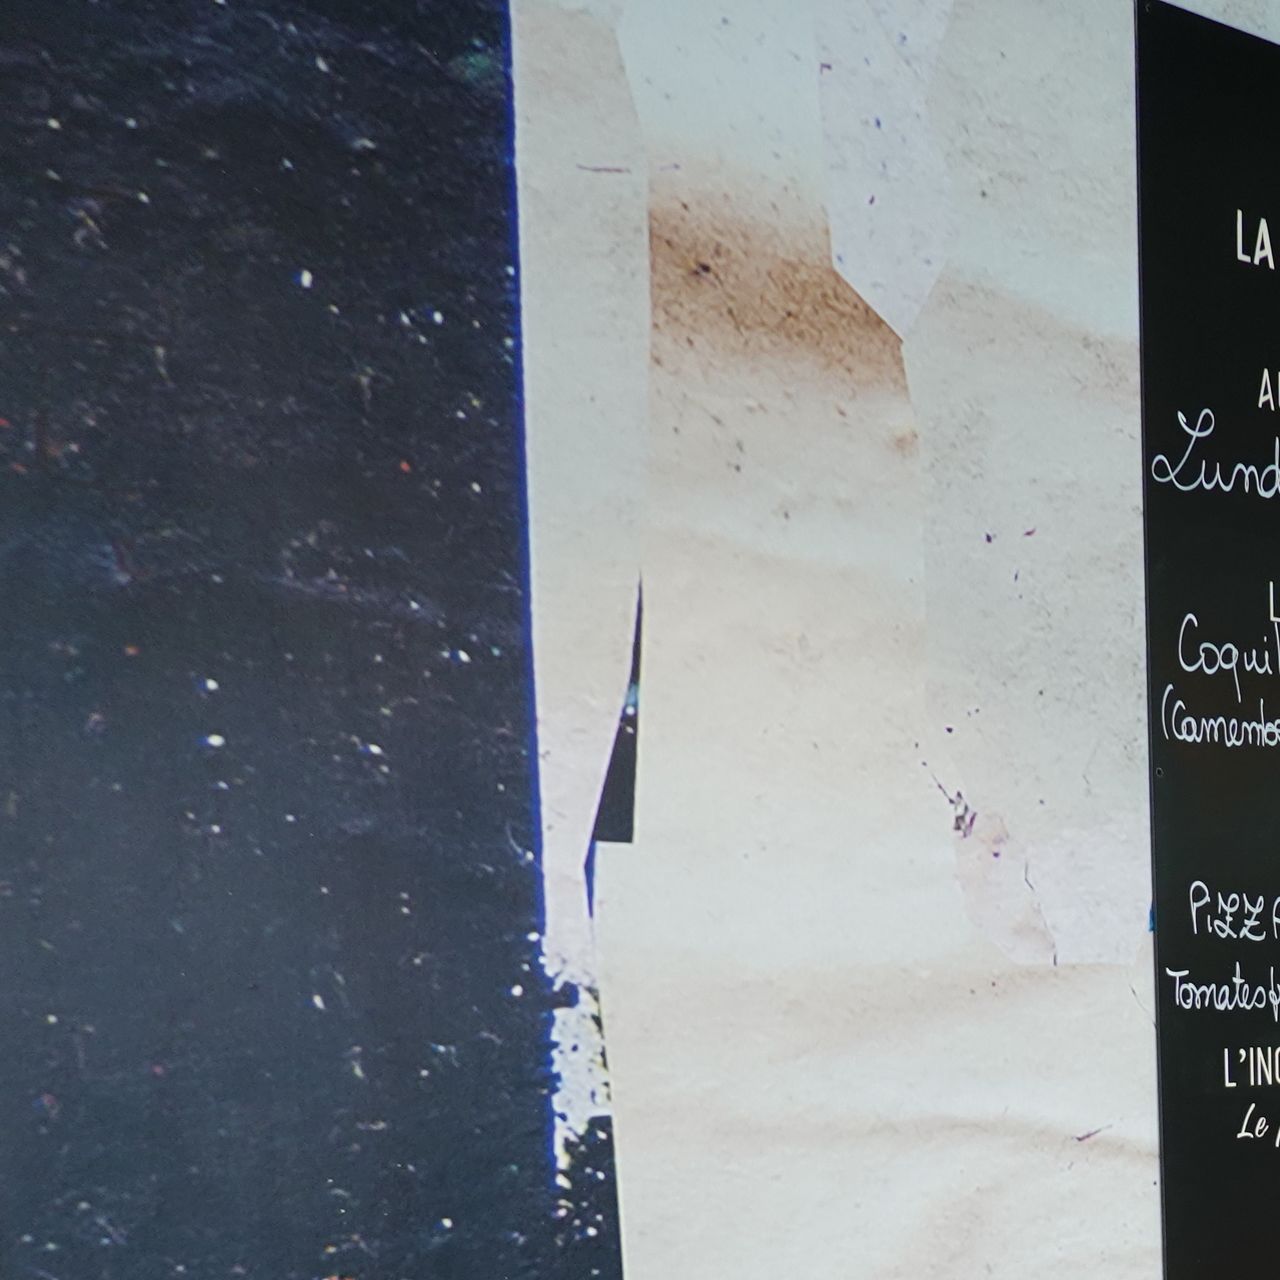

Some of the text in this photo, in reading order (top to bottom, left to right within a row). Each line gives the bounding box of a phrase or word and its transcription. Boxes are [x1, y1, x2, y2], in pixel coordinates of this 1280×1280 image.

[1237, 209, 1274, 269] LA
[1166, 961, 1266, 1010] Tomates
[1237, 1103, 1269, 1138] Le
